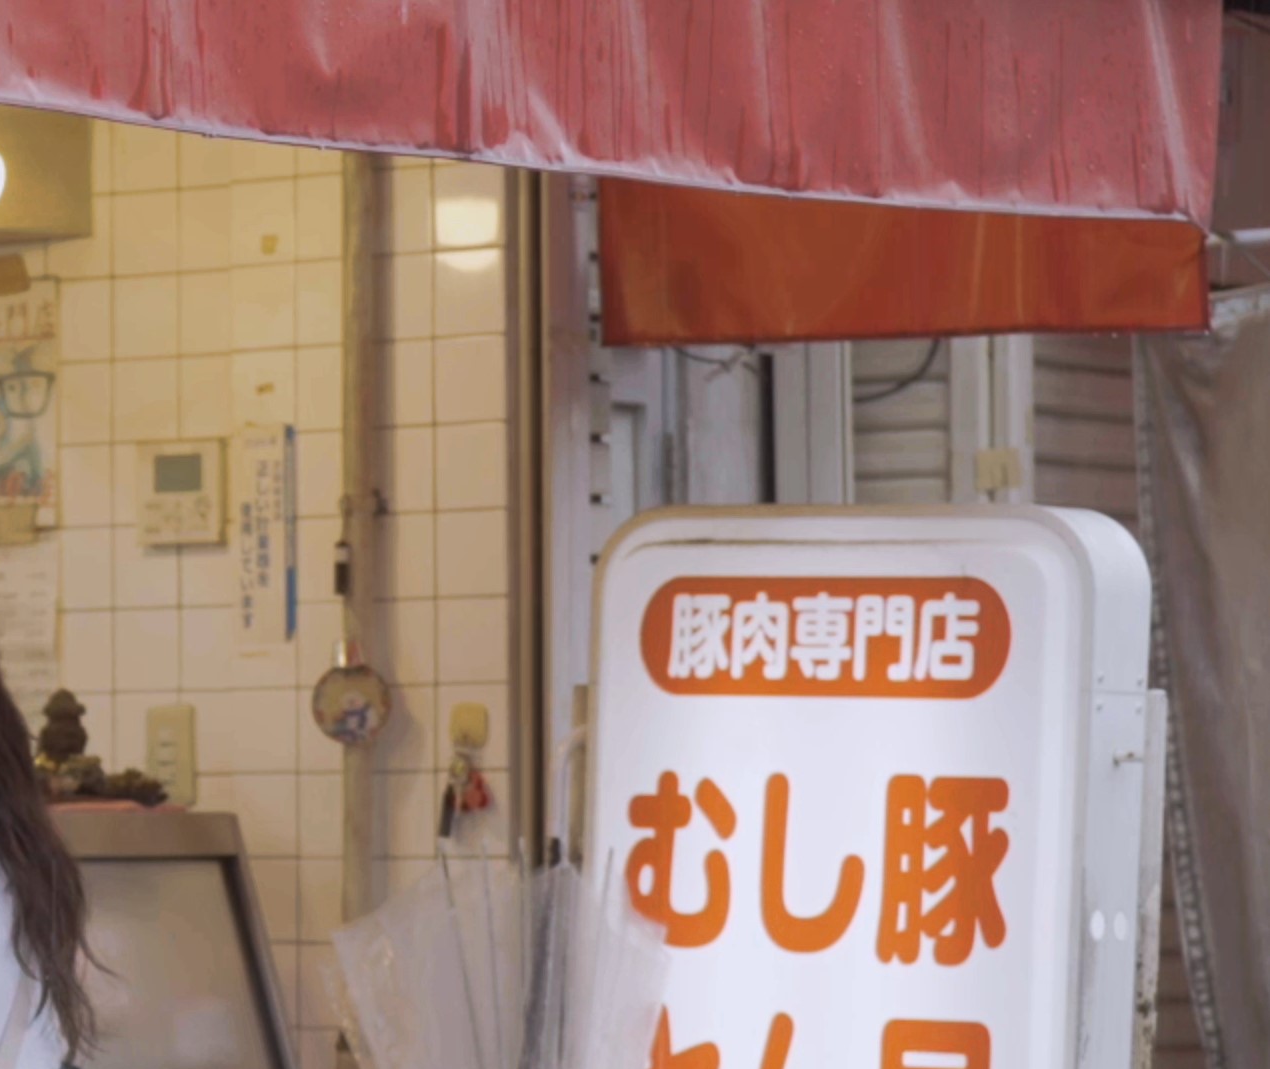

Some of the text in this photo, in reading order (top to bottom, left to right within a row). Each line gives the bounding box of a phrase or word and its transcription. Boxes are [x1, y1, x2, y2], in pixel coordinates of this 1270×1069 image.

[668, 591, 980, 683] 豚肉専門店
[624, 770, 1010, 966] むし豚
